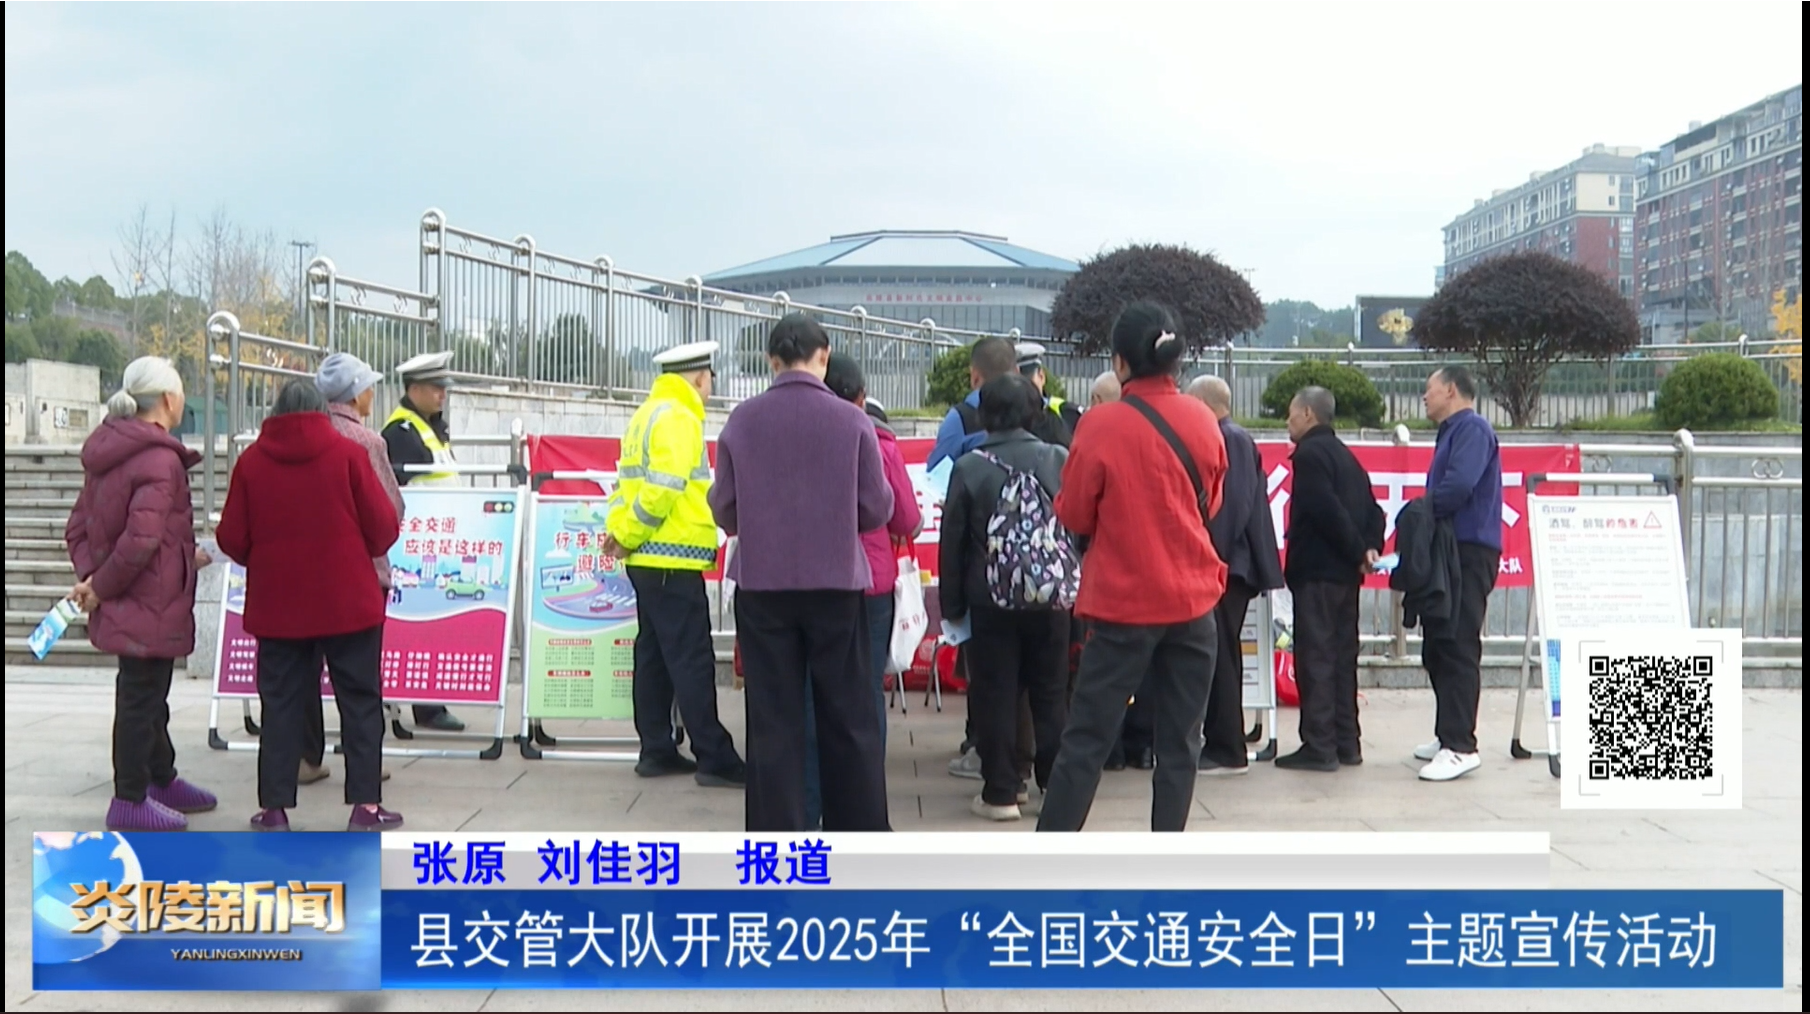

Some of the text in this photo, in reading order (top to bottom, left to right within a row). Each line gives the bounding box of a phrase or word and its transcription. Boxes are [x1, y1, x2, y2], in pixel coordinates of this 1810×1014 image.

[405, 539, 503, 556] 应该是这样的
[577, 554, 624, 572] 避险
